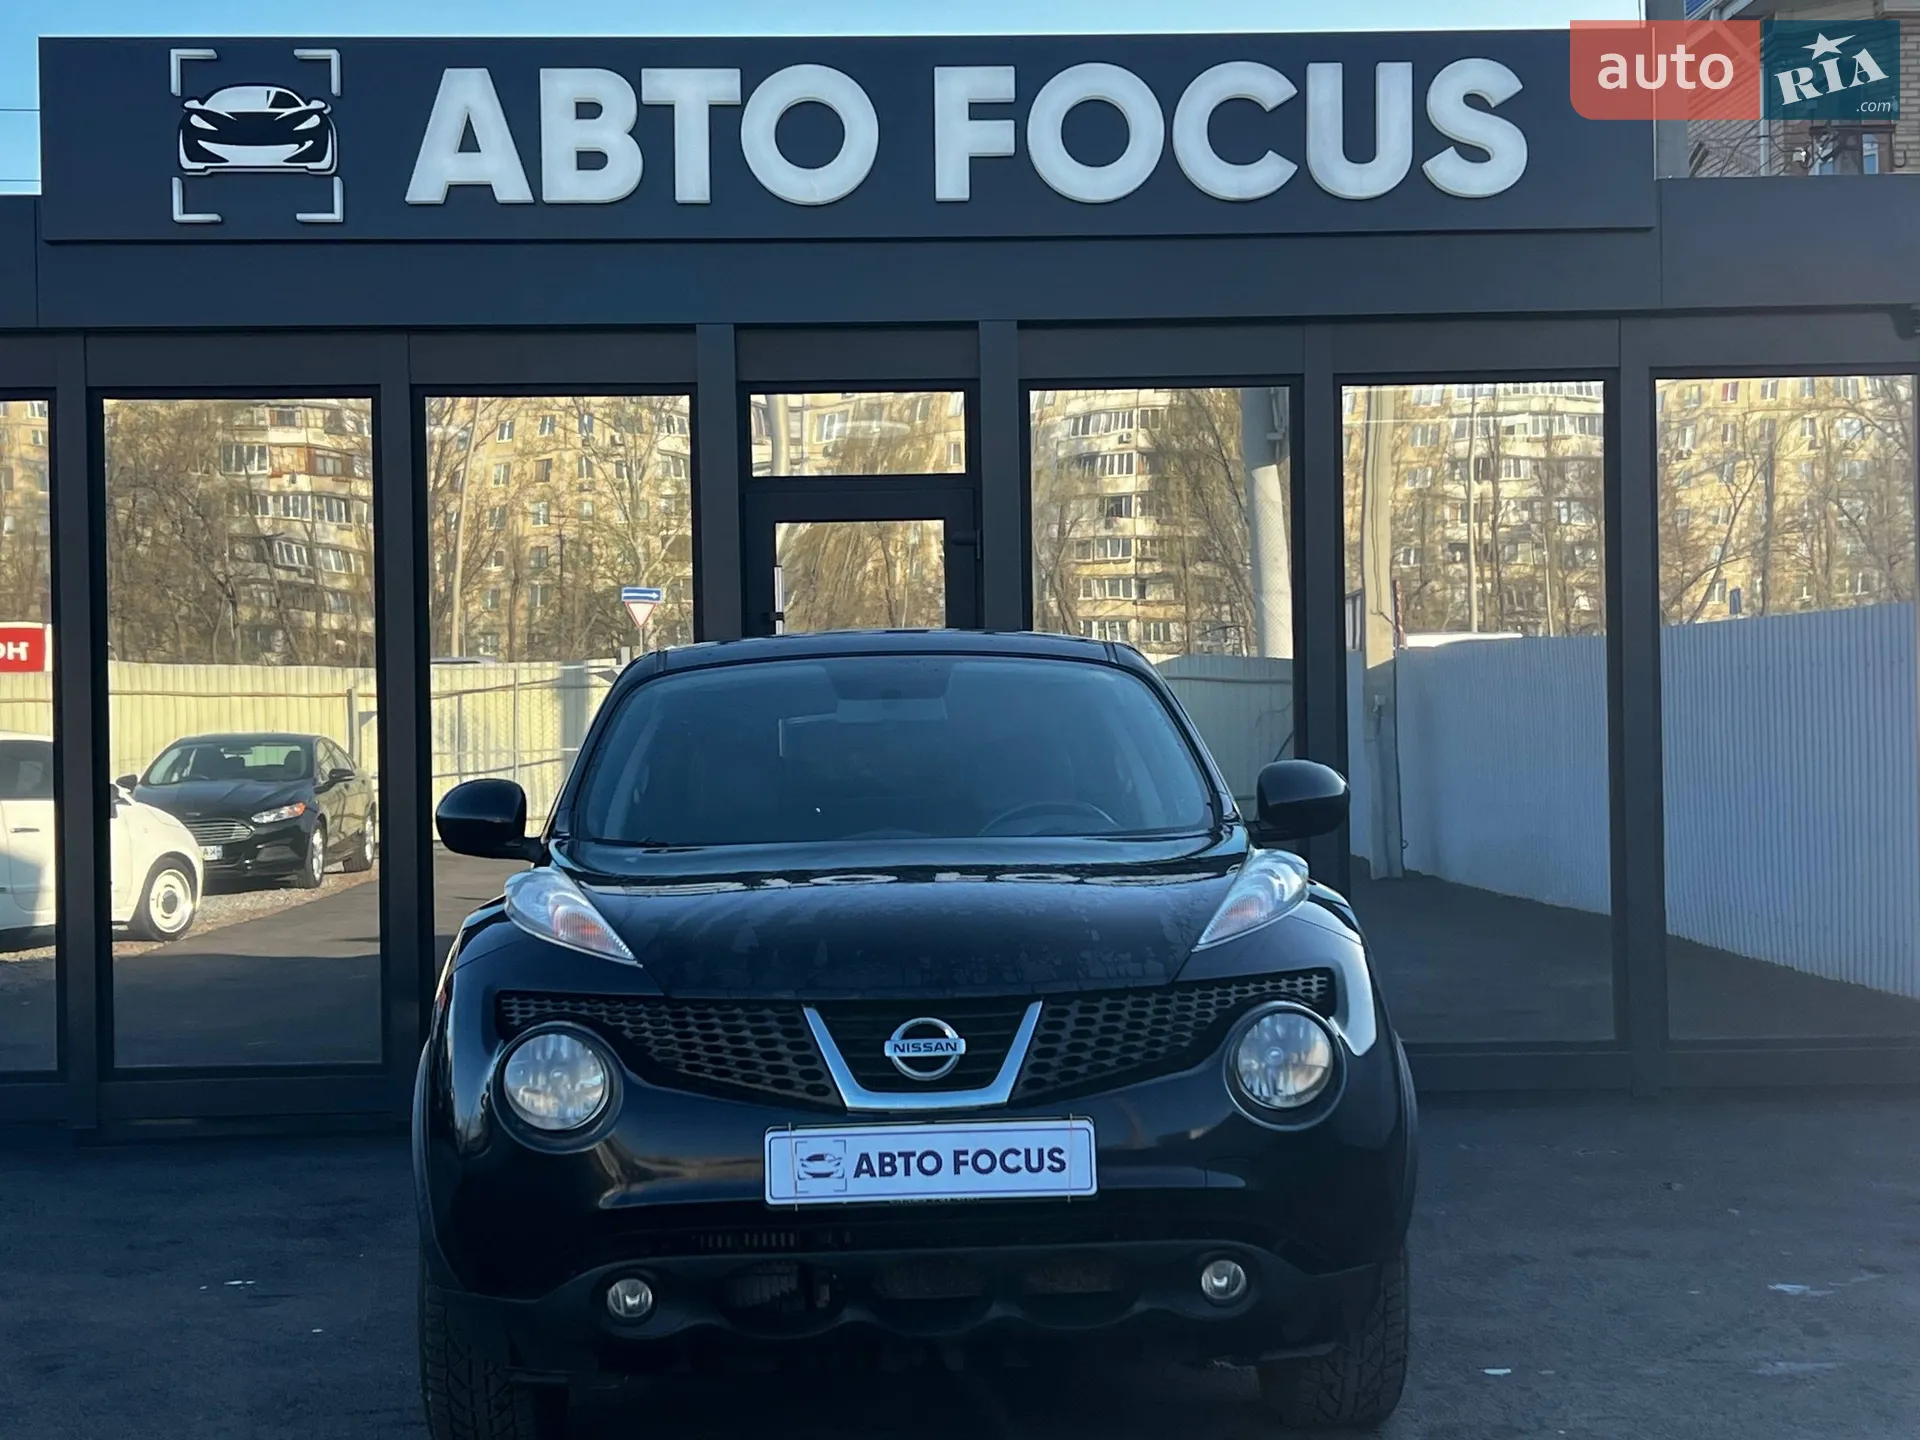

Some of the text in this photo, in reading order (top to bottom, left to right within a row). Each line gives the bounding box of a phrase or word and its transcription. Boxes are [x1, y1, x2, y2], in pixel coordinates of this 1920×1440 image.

[405, 57, 1528, 206] АВТО FOCUS
[893, 1042, 957, 1053] NISSAN
[853, 1146, 1067, 1179] АВТО FOCUS
